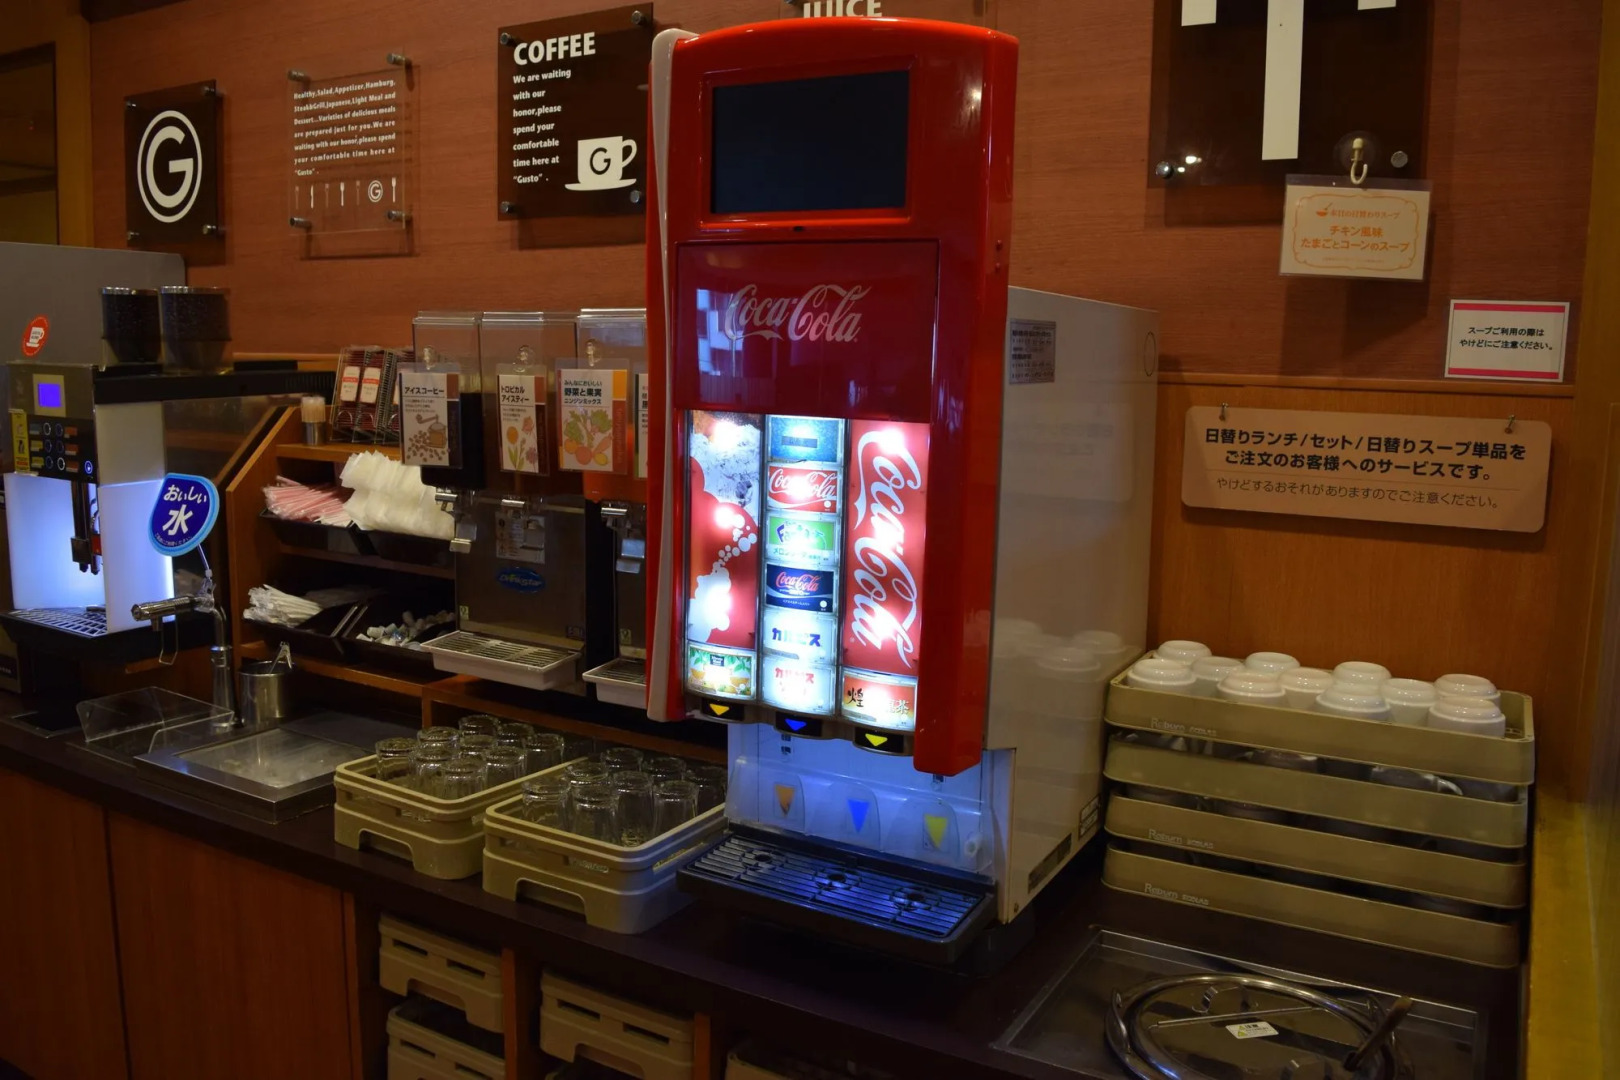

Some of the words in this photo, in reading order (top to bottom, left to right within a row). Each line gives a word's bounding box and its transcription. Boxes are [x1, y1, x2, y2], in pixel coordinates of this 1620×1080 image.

[513, 31, 596, 66] COFFEE
[513, 75, 526, 84] We
[527, 73, 540, 82] are
[541, 69, 572, 80] waiting
[369, 93, 383, 101] Meal
[384, 91, 396, 100] and
[513, 91, 530, 101] with
[532, 90, 546, 98] our
[352, 108, 377, 118] delicious
[379, 105, 396, 113] meals
[513, 104, 562, 117] honor,please
[305, 126, 332, 138] prepared
[334, 125, 346, 135] just
[348, 124, 357, 132] for
[513, 123, 535, 136] spend
[537, 122, 555, 134] your
[294, 142, 315, 151] waiting
[316, 140, 329, 148] with
[378, 133, 396, 142] spend
[513, 138, 560, 151] comfortable
[294, 157, 308, 165] your
[310, 151, 350, 162] comfortable
[352, 149, 368, 158] time
[370, 148, 385, 156] here
[513, 158, 530, 168] time
[532, 156, 550, 166] here
[551, 155, 560, 164] at
[590, 147, 611, 175] G
[146, 125, 194, 208] G
[1330, 225, 1384, 238] チキン風味
[1301, 238, 1411, 253] たまごとコーンのスープ
[724, 284, 872, 343] Coca-Cola
[1468, 326, 1545, 337] スープご利用の際は
[1459, 339, 1553, 350] やけどにご注意ください。
[404, 386, 445, 395] アイスコーヒー
[501, 385, 525, 394] トロピカル
[564, 387, 602, 397] 野菜と果実
[501, 394, 530, 403] アイスティー
[1205, 428, 1526, 460] 日替りランチ/セット/日替りスープ単品を
[1225, 450, 1490, 480] ご注文のお客様へのサービスです。
[769, 468, 838, 501] Cocola
[163, 484, 207, 504] おいしい
[1217, 477, 1498, 509] やけどするおそれがありますのでご注意ください。
[162, 504, 193, 536] 水
[776, 571, 821, 592] Coca-Cola
[775, 667, 815, 684] カス
